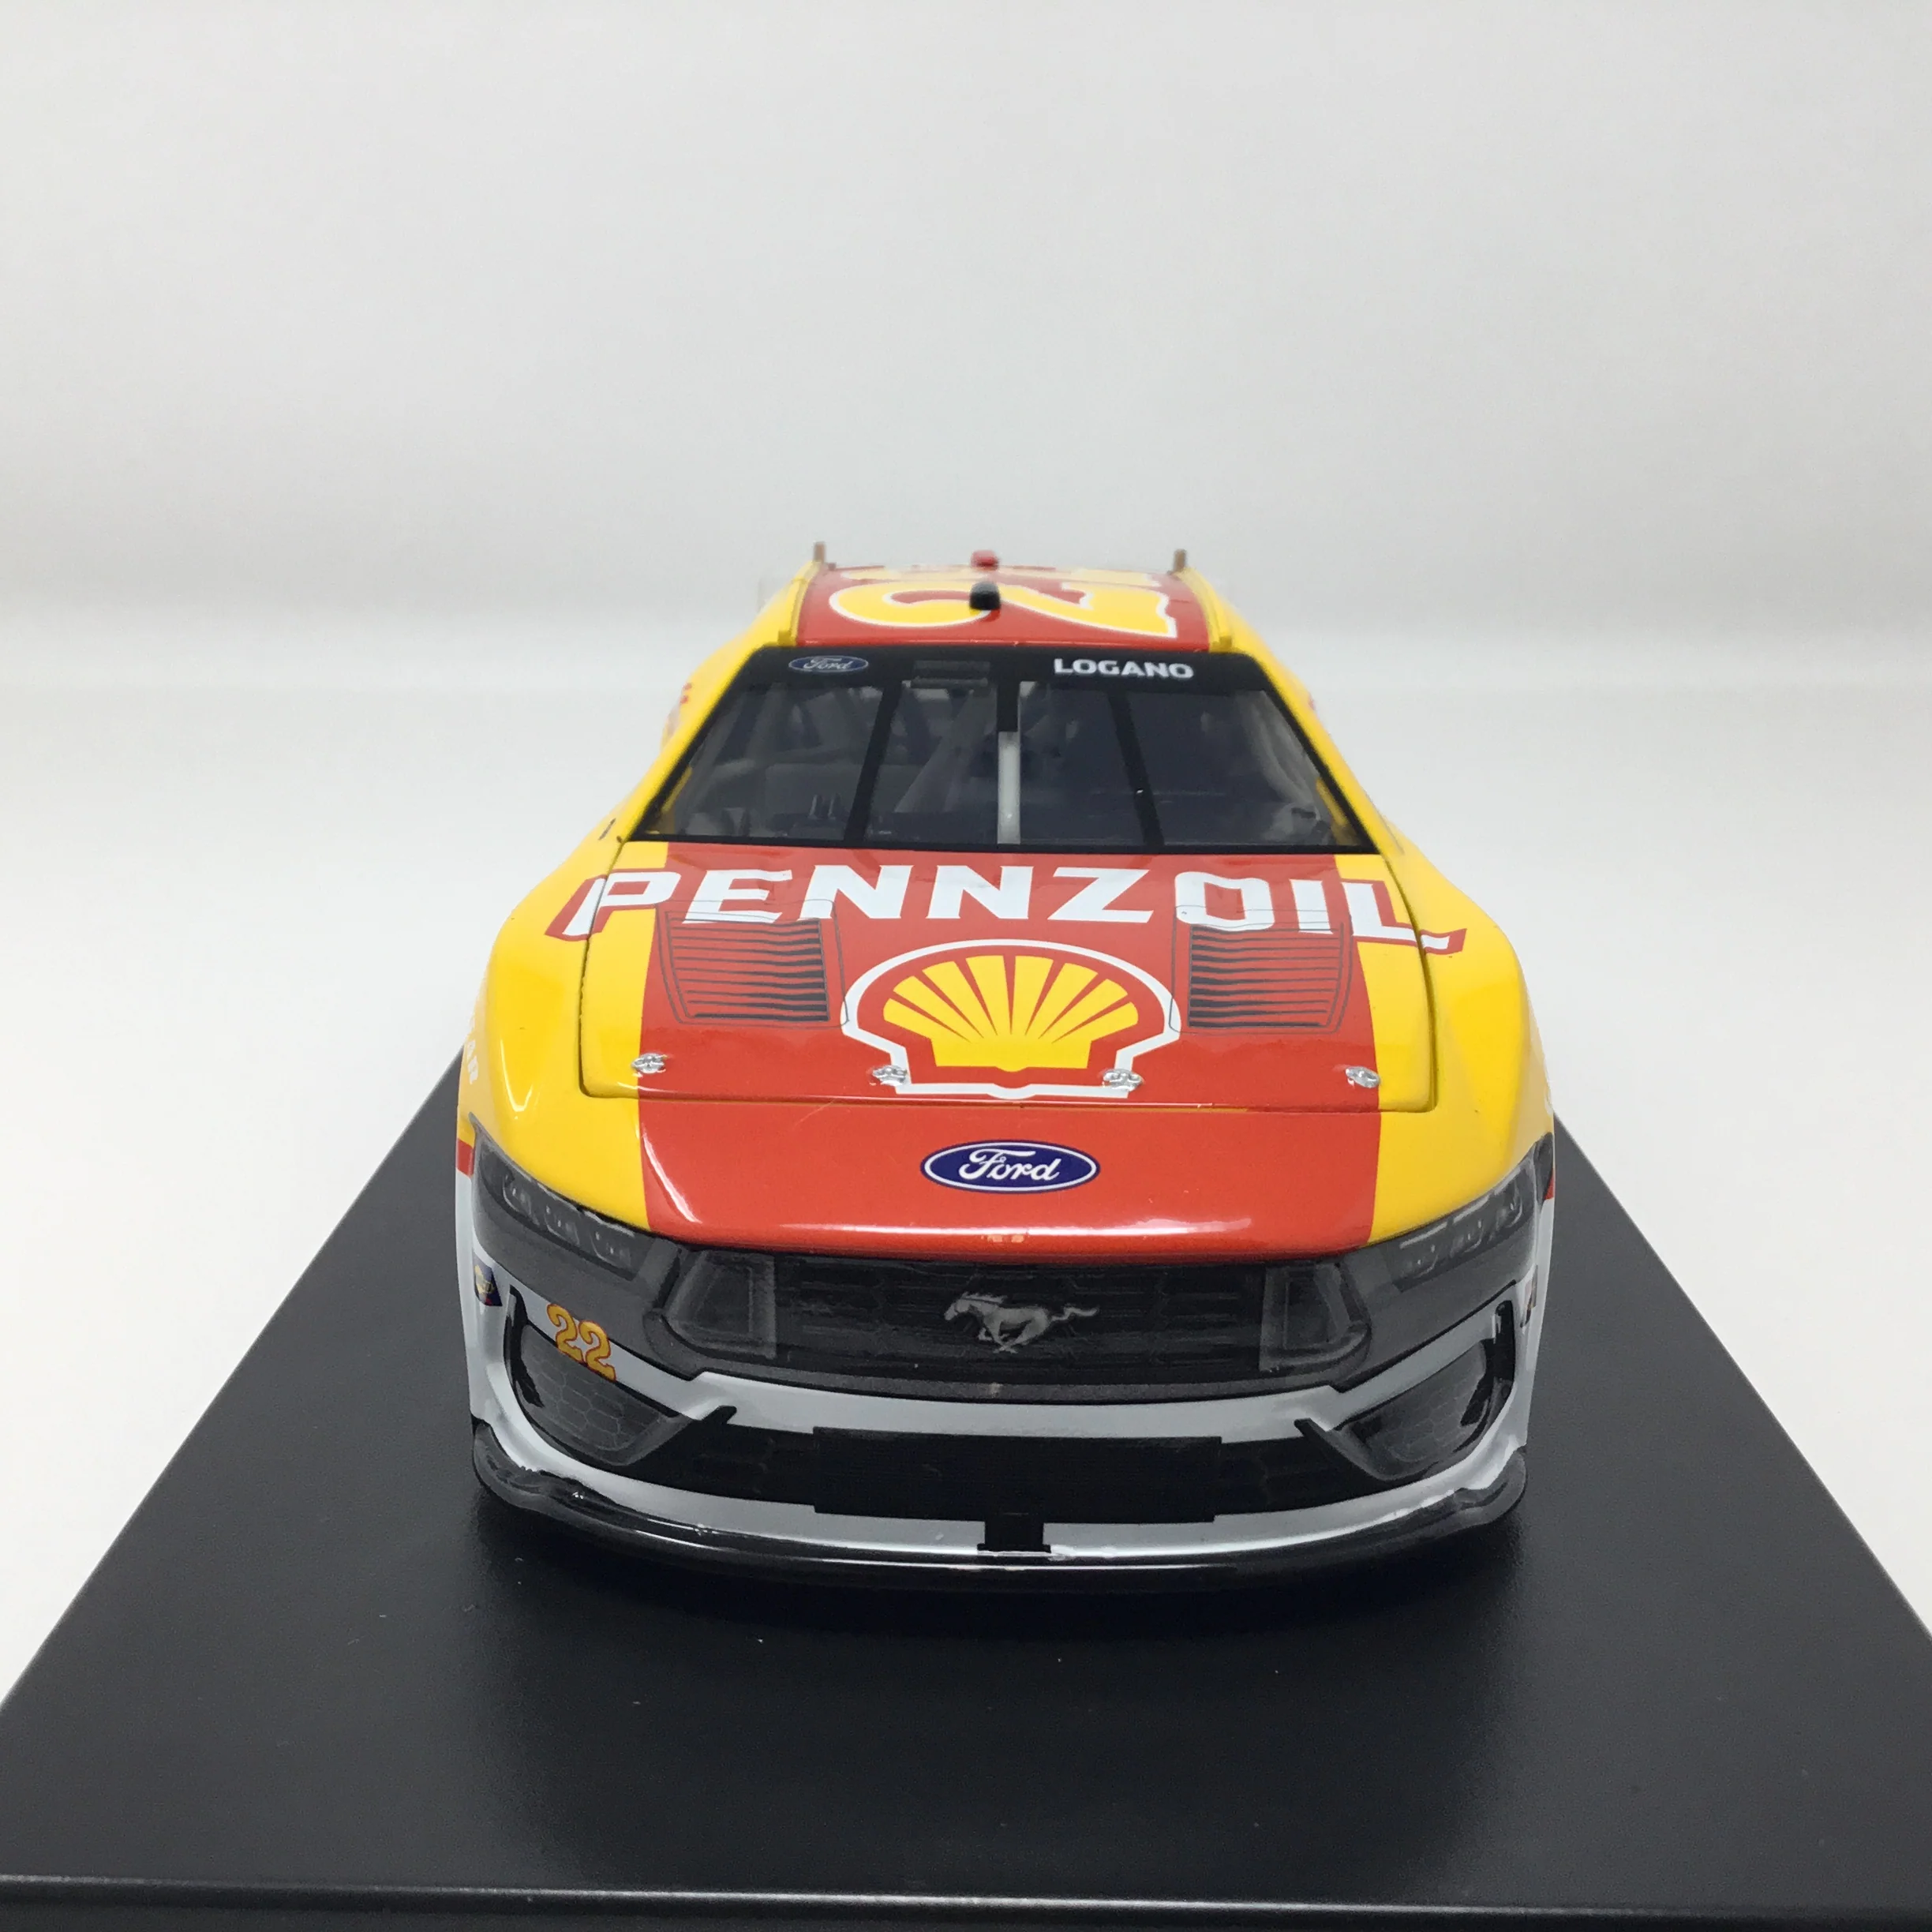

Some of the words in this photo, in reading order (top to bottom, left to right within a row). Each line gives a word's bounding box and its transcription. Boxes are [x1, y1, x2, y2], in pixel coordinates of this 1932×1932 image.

[803, 657, 854, 670] Ford
[1053, 658, 1194, 679] LOGANO
[561, 864, 1451, 949] PENNZOIL
[958, 1148, 1062, 1181] Ford
[546, 1303, 616, 1382] 22
